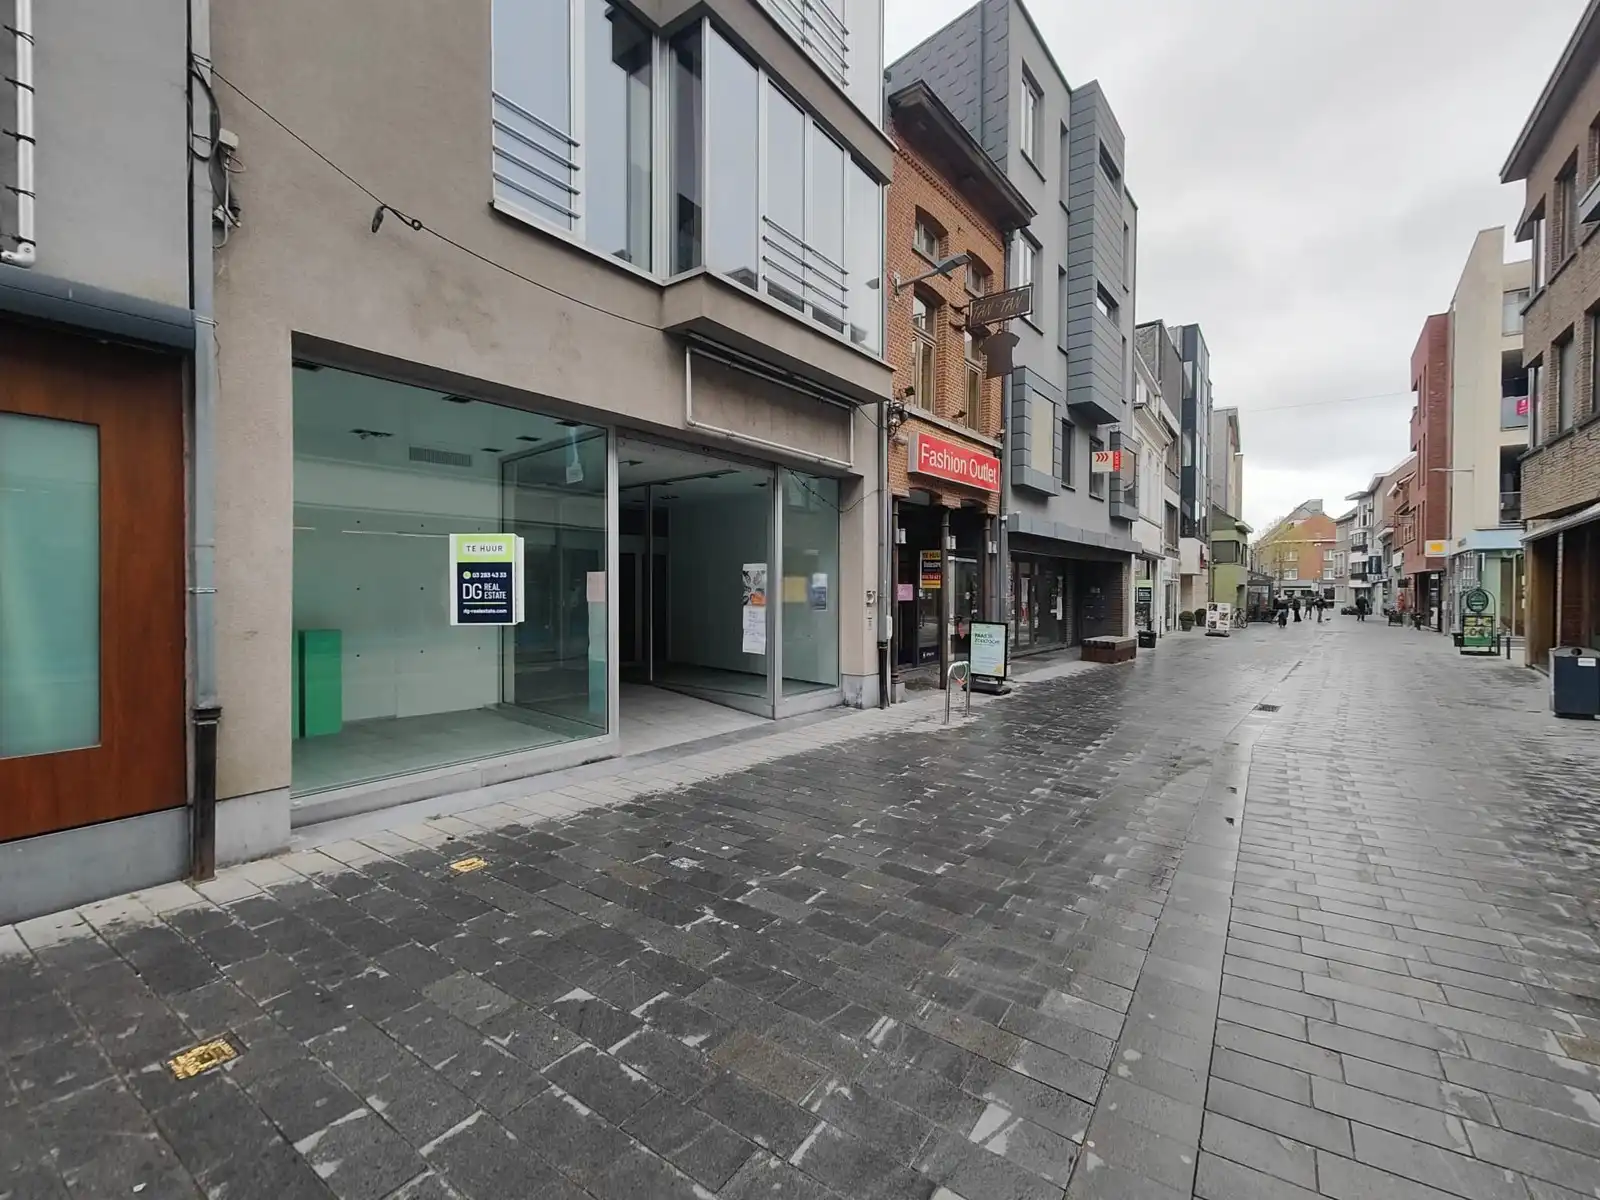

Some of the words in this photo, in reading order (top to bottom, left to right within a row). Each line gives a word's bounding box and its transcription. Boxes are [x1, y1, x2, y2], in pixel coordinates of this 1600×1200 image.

[921, 443, 967, 475] Fashion
[969, 459, 996, 484] Outlet
[462, 583, 482, 599] DG
[484, 583, 500, 591] REAL
[484, 591, 507, 599] ESTATE
